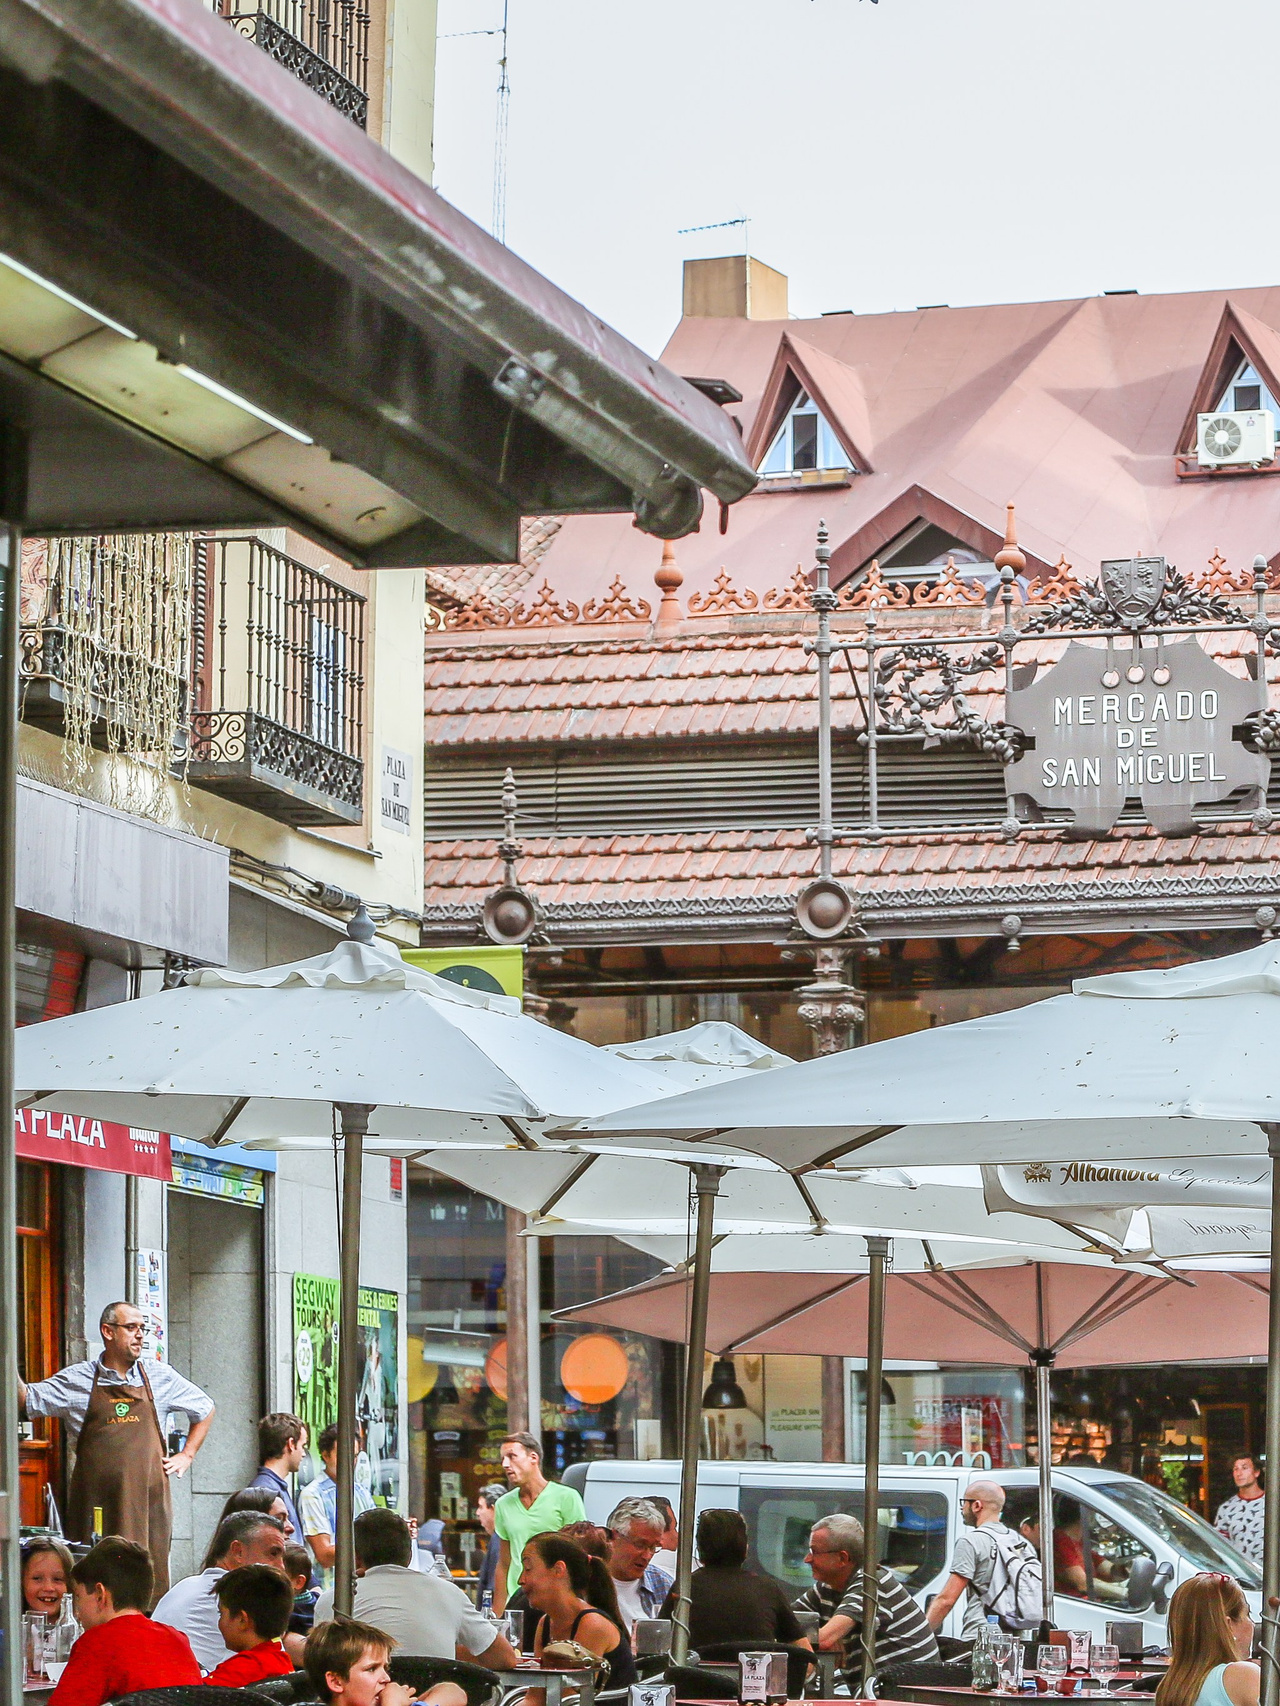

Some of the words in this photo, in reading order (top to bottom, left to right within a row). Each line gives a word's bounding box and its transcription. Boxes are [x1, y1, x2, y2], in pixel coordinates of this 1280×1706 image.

[1053, 689, 1219, 726] MERCADO
[1116, 727, 1158, 748] DE
[386, 755, 406, 780] PLAZA
[1041, 757, 1101, 788] SAN
[393, 782, 400, 798] DE
[381, 797, 392, 818] SAN
[31, 1109, 106, 1149] PLAZA
[296, 1277, 336, 1311] SEGWAY
[358, 1288, 373, 1307] IKES
[296, 1306, 321, 1328] TOURS
[358, 1307, 381, 1328] ENTAL
